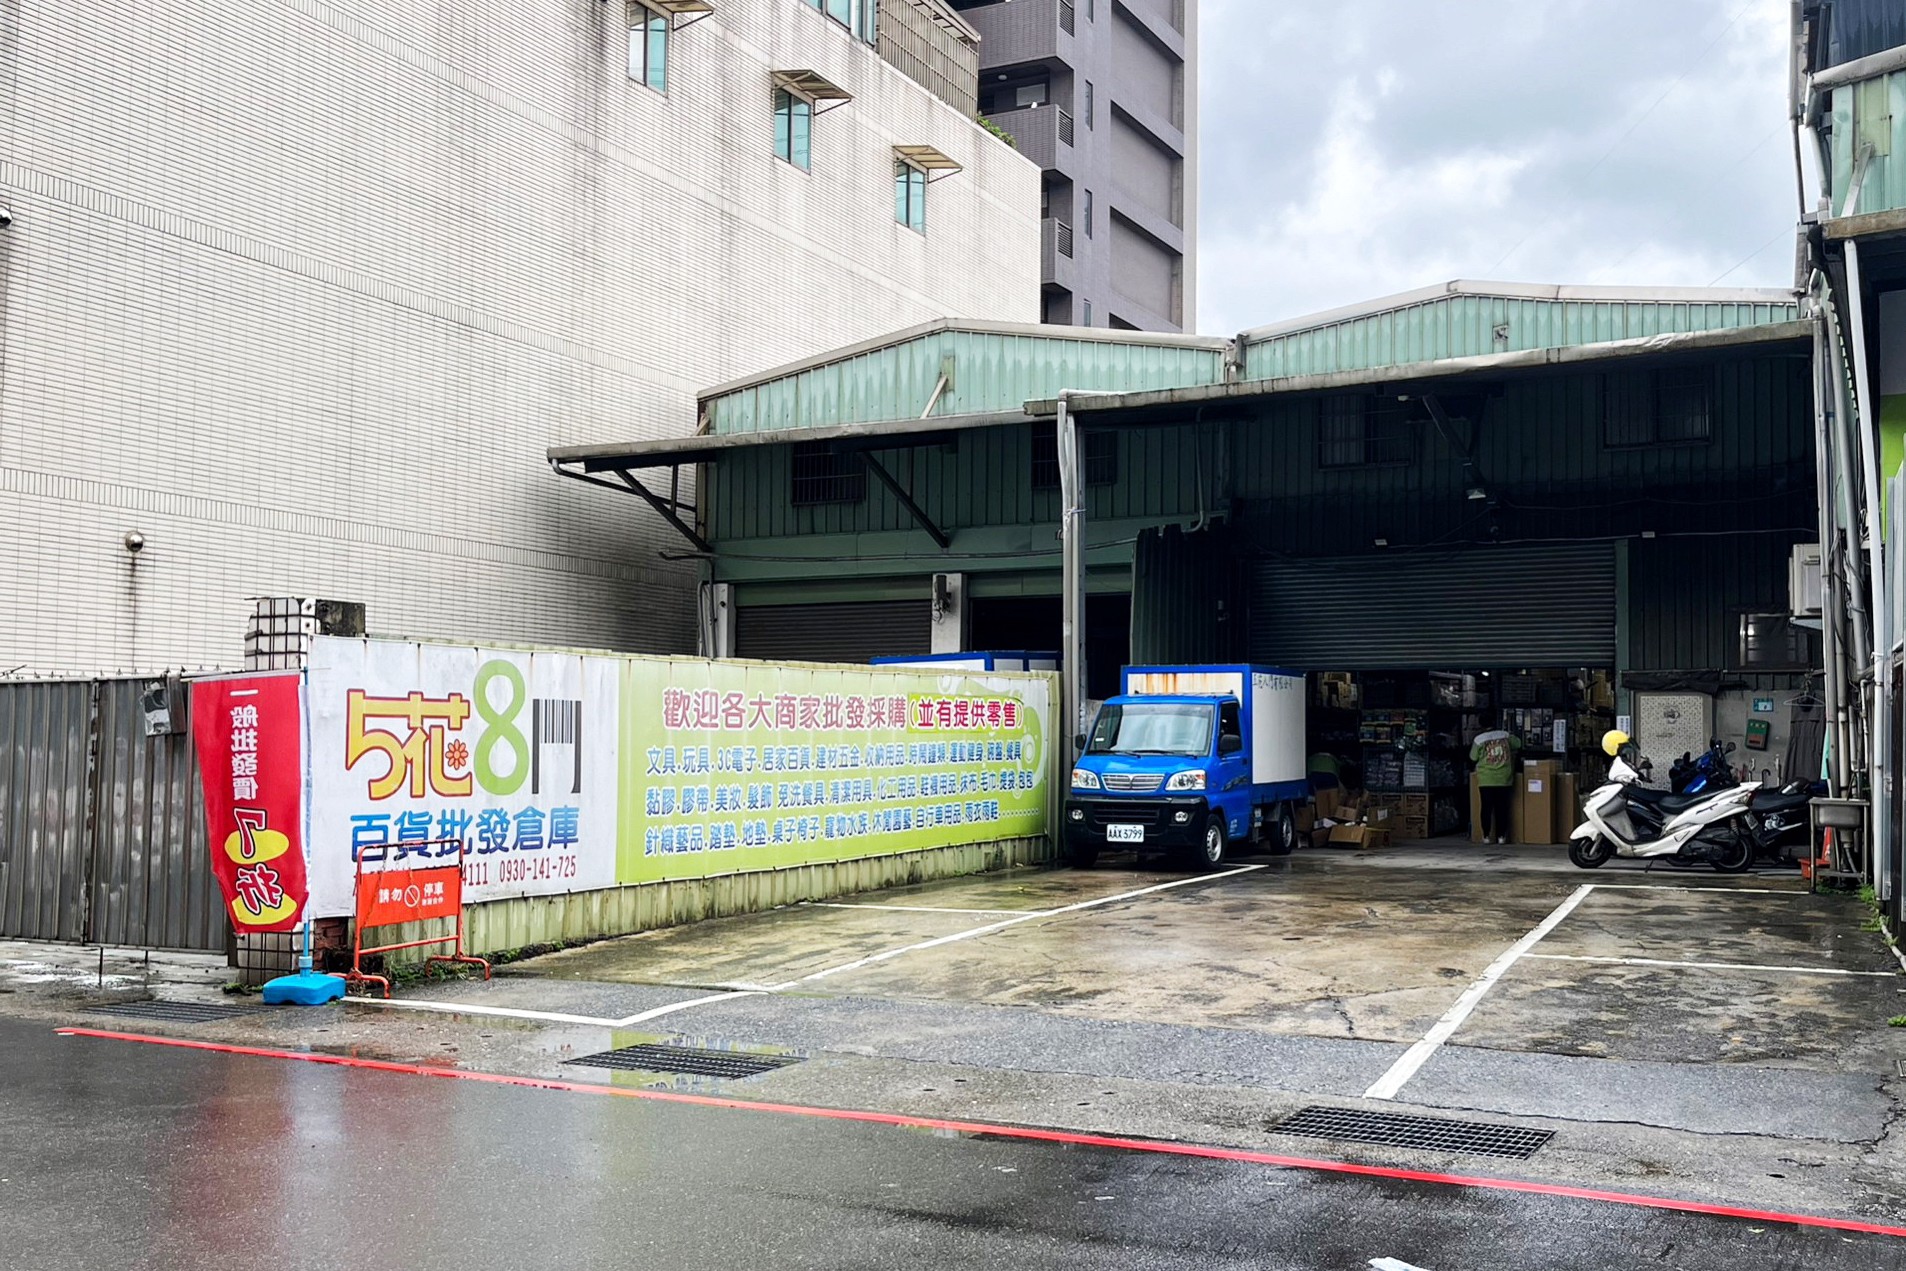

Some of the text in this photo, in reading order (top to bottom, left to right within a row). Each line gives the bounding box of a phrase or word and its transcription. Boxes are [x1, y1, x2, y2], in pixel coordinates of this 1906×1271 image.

[350, 805, 580, 862] 百貨批發倉庫
[500, 855, 576, 882] 0930-141-725
[424, 881, 444, 897] 停車
